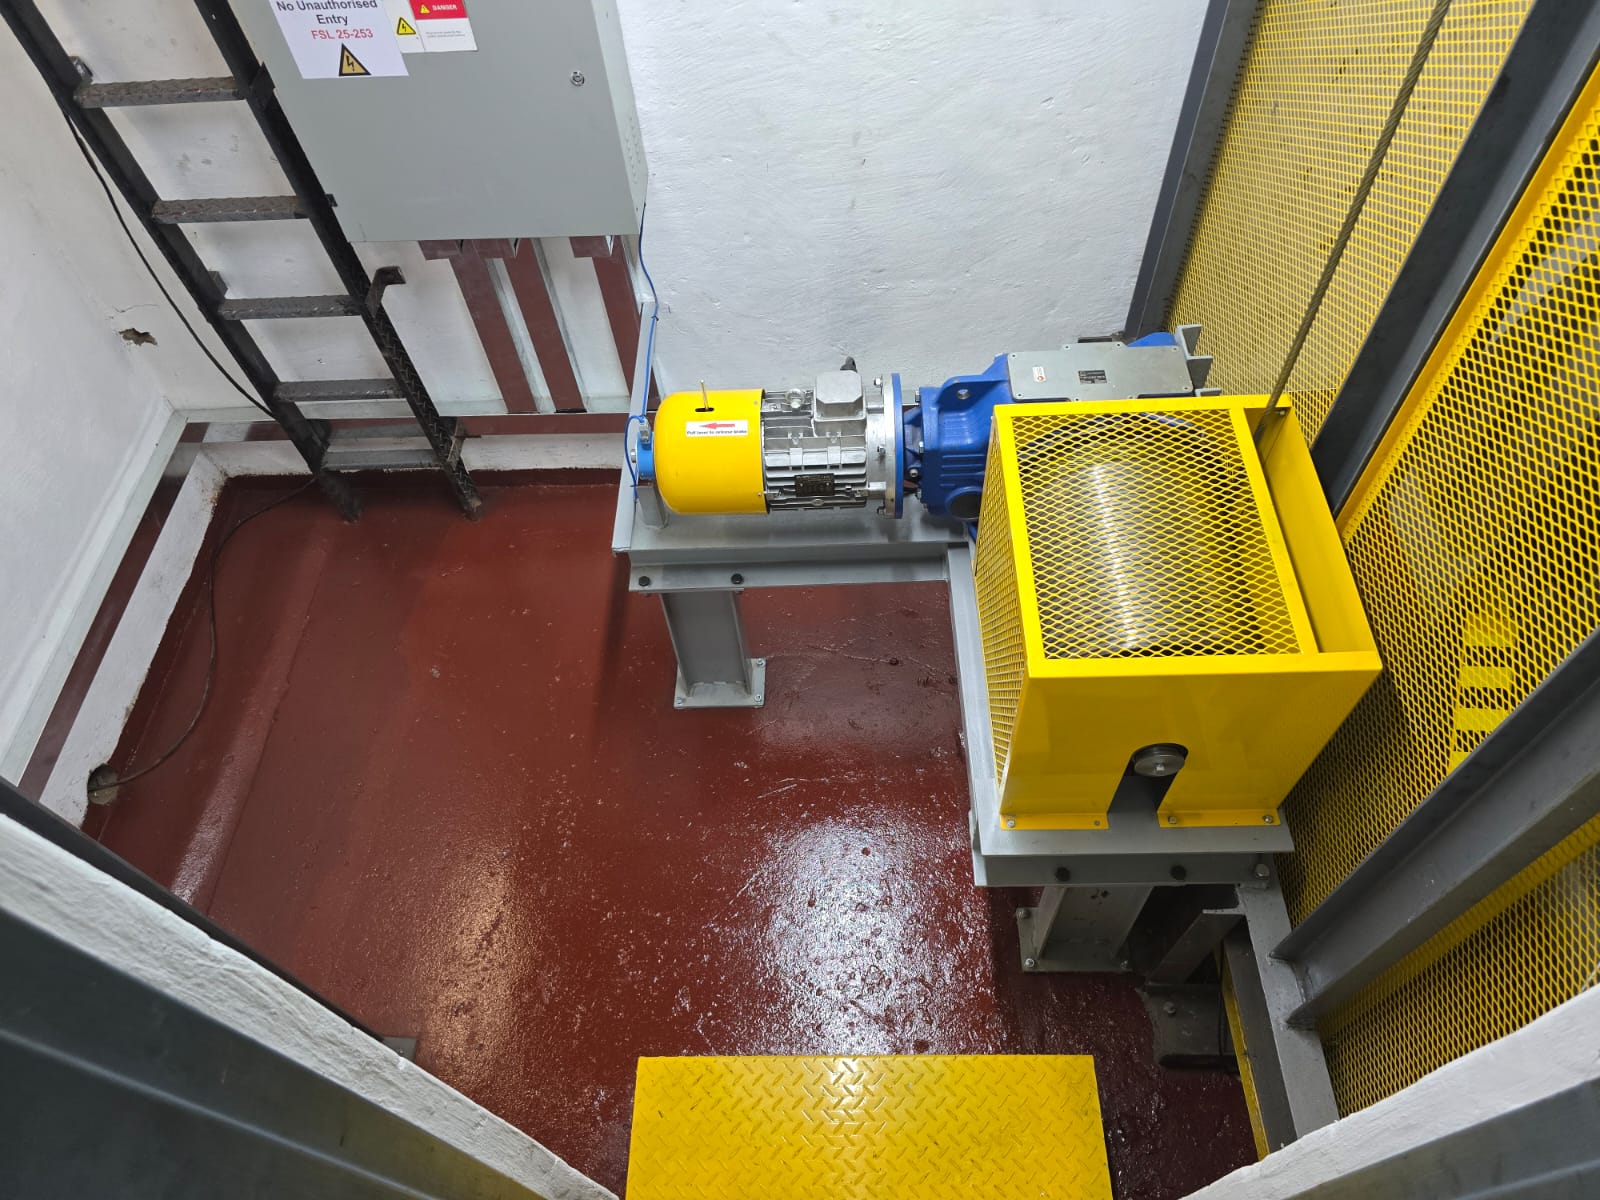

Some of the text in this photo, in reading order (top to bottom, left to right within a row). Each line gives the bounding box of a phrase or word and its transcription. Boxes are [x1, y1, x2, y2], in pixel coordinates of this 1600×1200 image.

[276, 0, 378, 11] No Unauthorised
[316, 14, 348, 26] Entry
[311, 28, 373, 40] FSL 25-253
